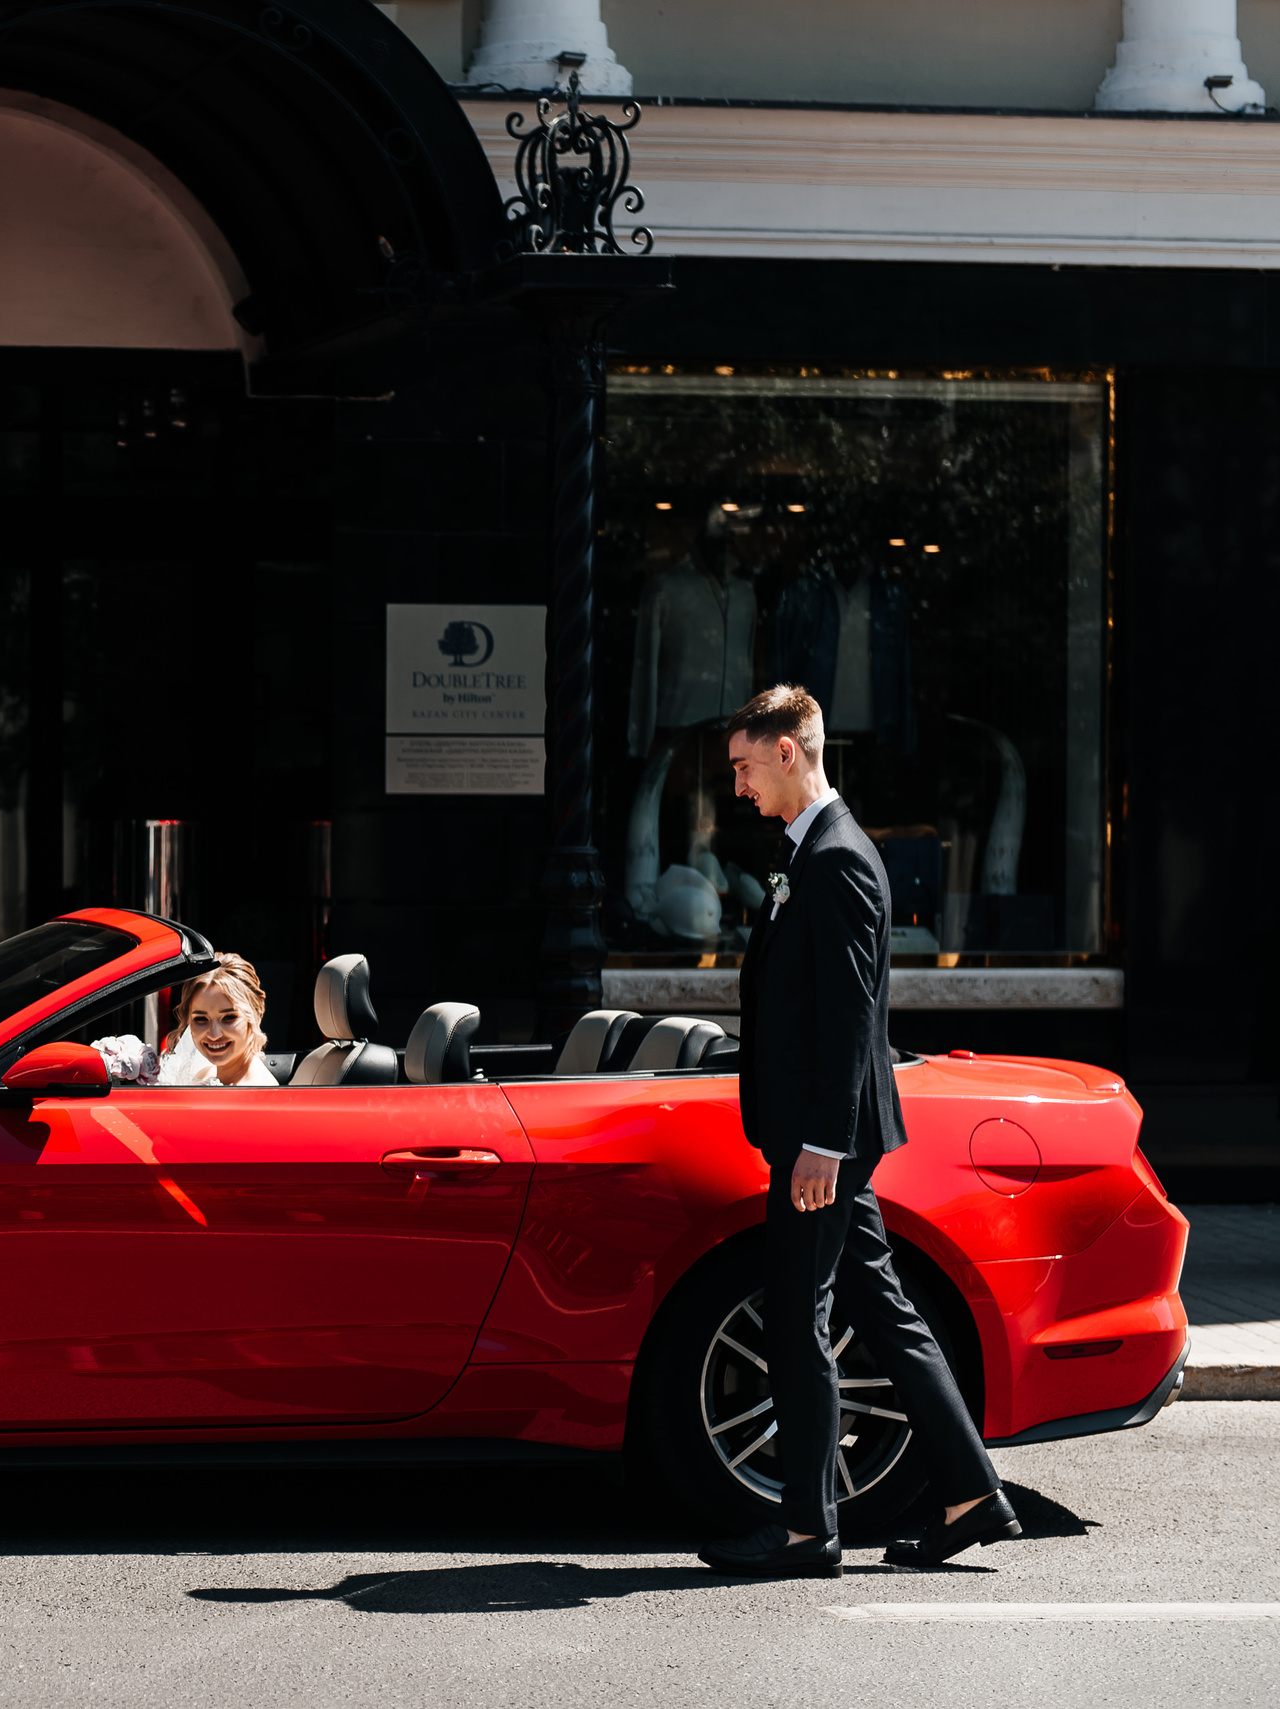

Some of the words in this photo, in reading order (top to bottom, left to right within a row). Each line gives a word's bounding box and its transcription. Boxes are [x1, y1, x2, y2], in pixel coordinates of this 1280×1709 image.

[442, 692, 455, 704] by
[457, 692, 492, 704] Hilton
[412, 709, 449, 719] KAZAN
[452, 710, 479, 719] CITY
[482, 710, 526, 720] CENTER
